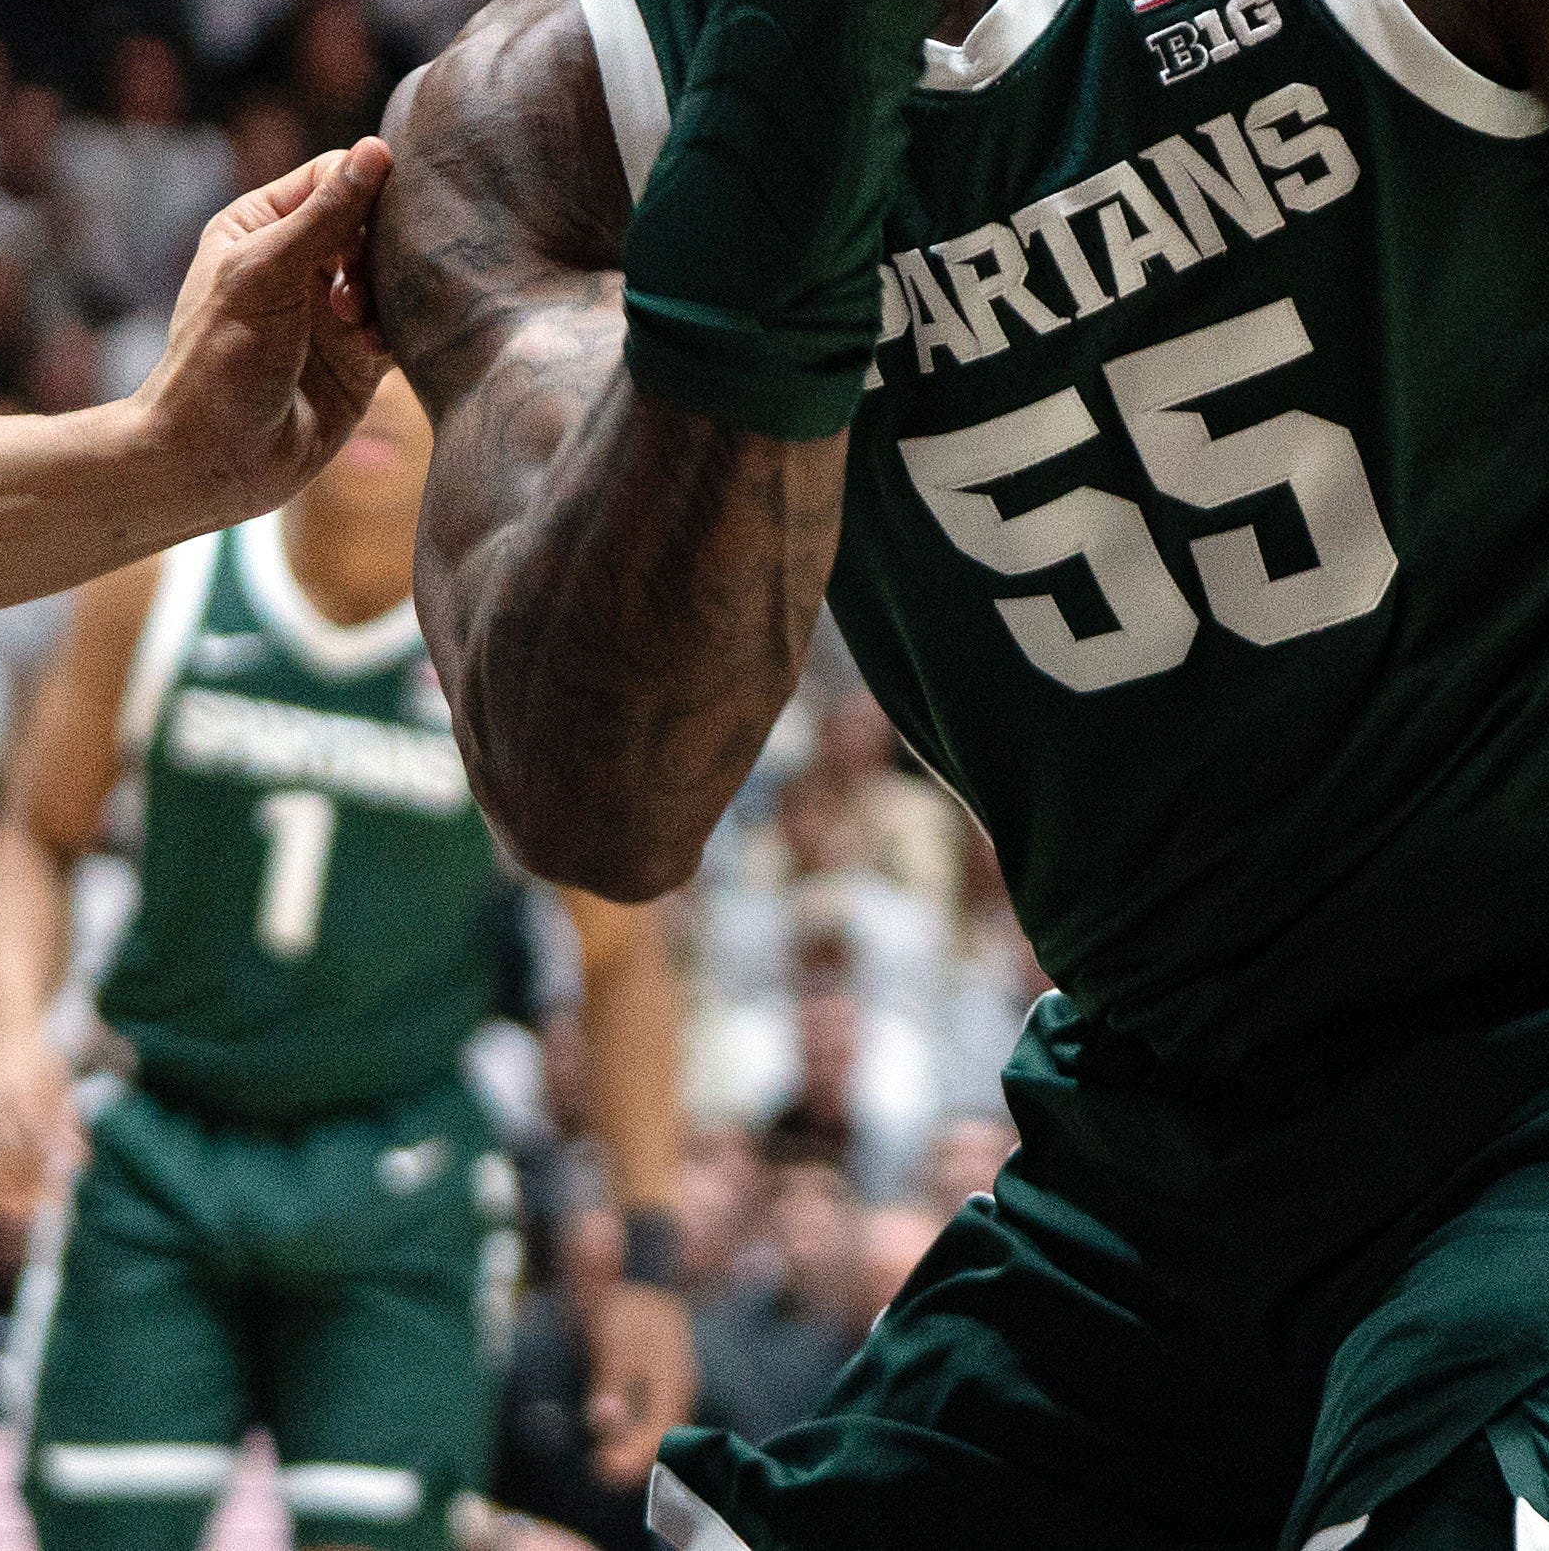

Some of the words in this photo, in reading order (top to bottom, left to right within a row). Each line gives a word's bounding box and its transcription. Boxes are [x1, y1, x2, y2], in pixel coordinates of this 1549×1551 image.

[862, 82, 1361, 392] PARTANS
[898, 296, 1399, 693] 55
[257, 788, 337, 958] 1
